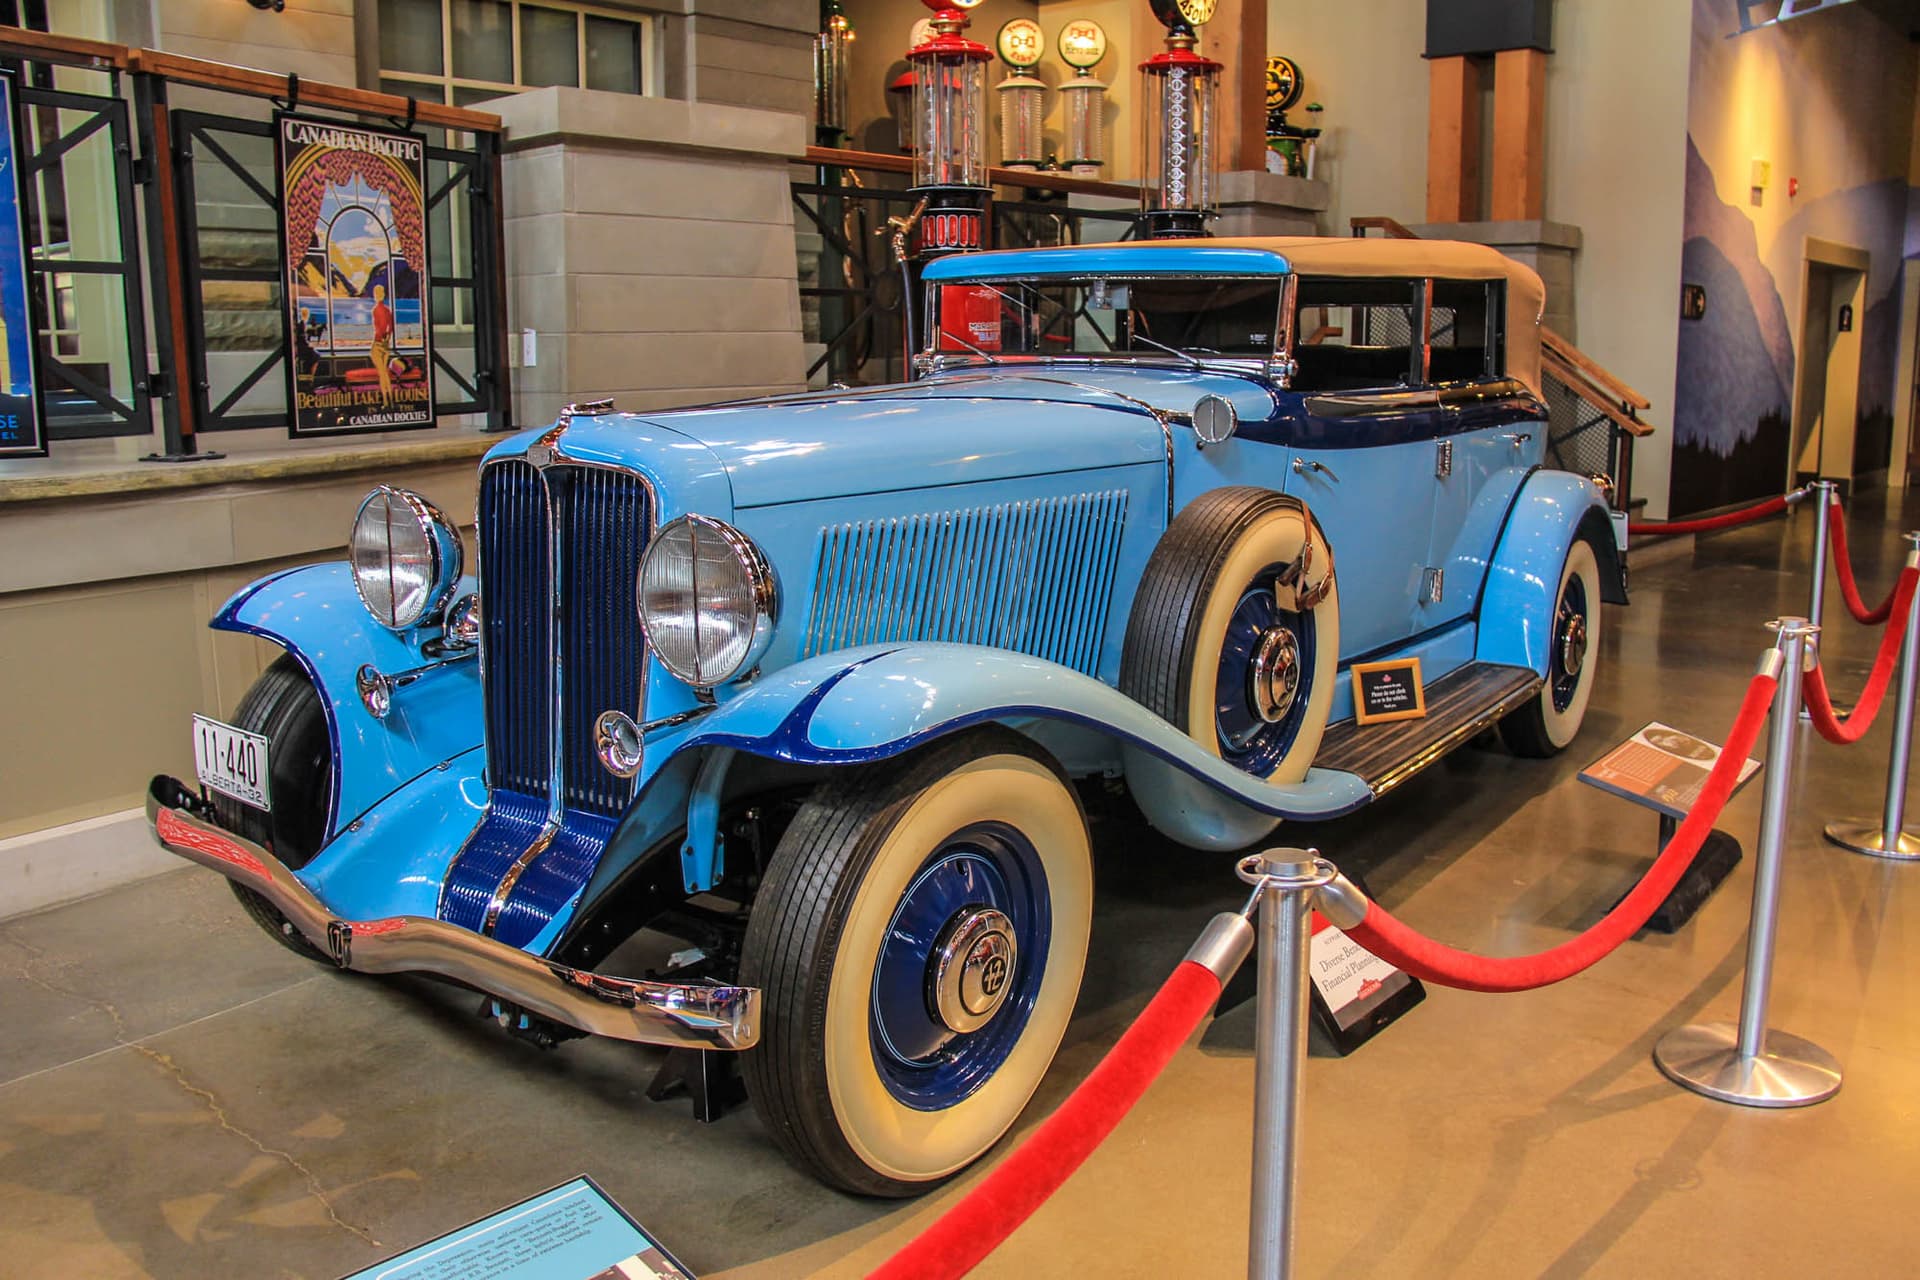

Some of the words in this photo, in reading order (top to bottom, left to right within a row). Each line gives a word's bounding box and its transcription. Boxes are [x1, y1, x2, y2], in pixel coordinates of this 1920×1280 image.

[285, 121, 366, 150] CANADIAN
[368, 132, 419, 161] PACIFIC
[298, 391, 352, 409] Beautiful
[354, 389, 381, 405] LAKE
[349, 413, 393, 426] CANADIAN
[394, 411, 427, 422] ROCKIES
[1319, 952, 1345, 973] Diverse
[1322, 966, 1352, 992] Financial
